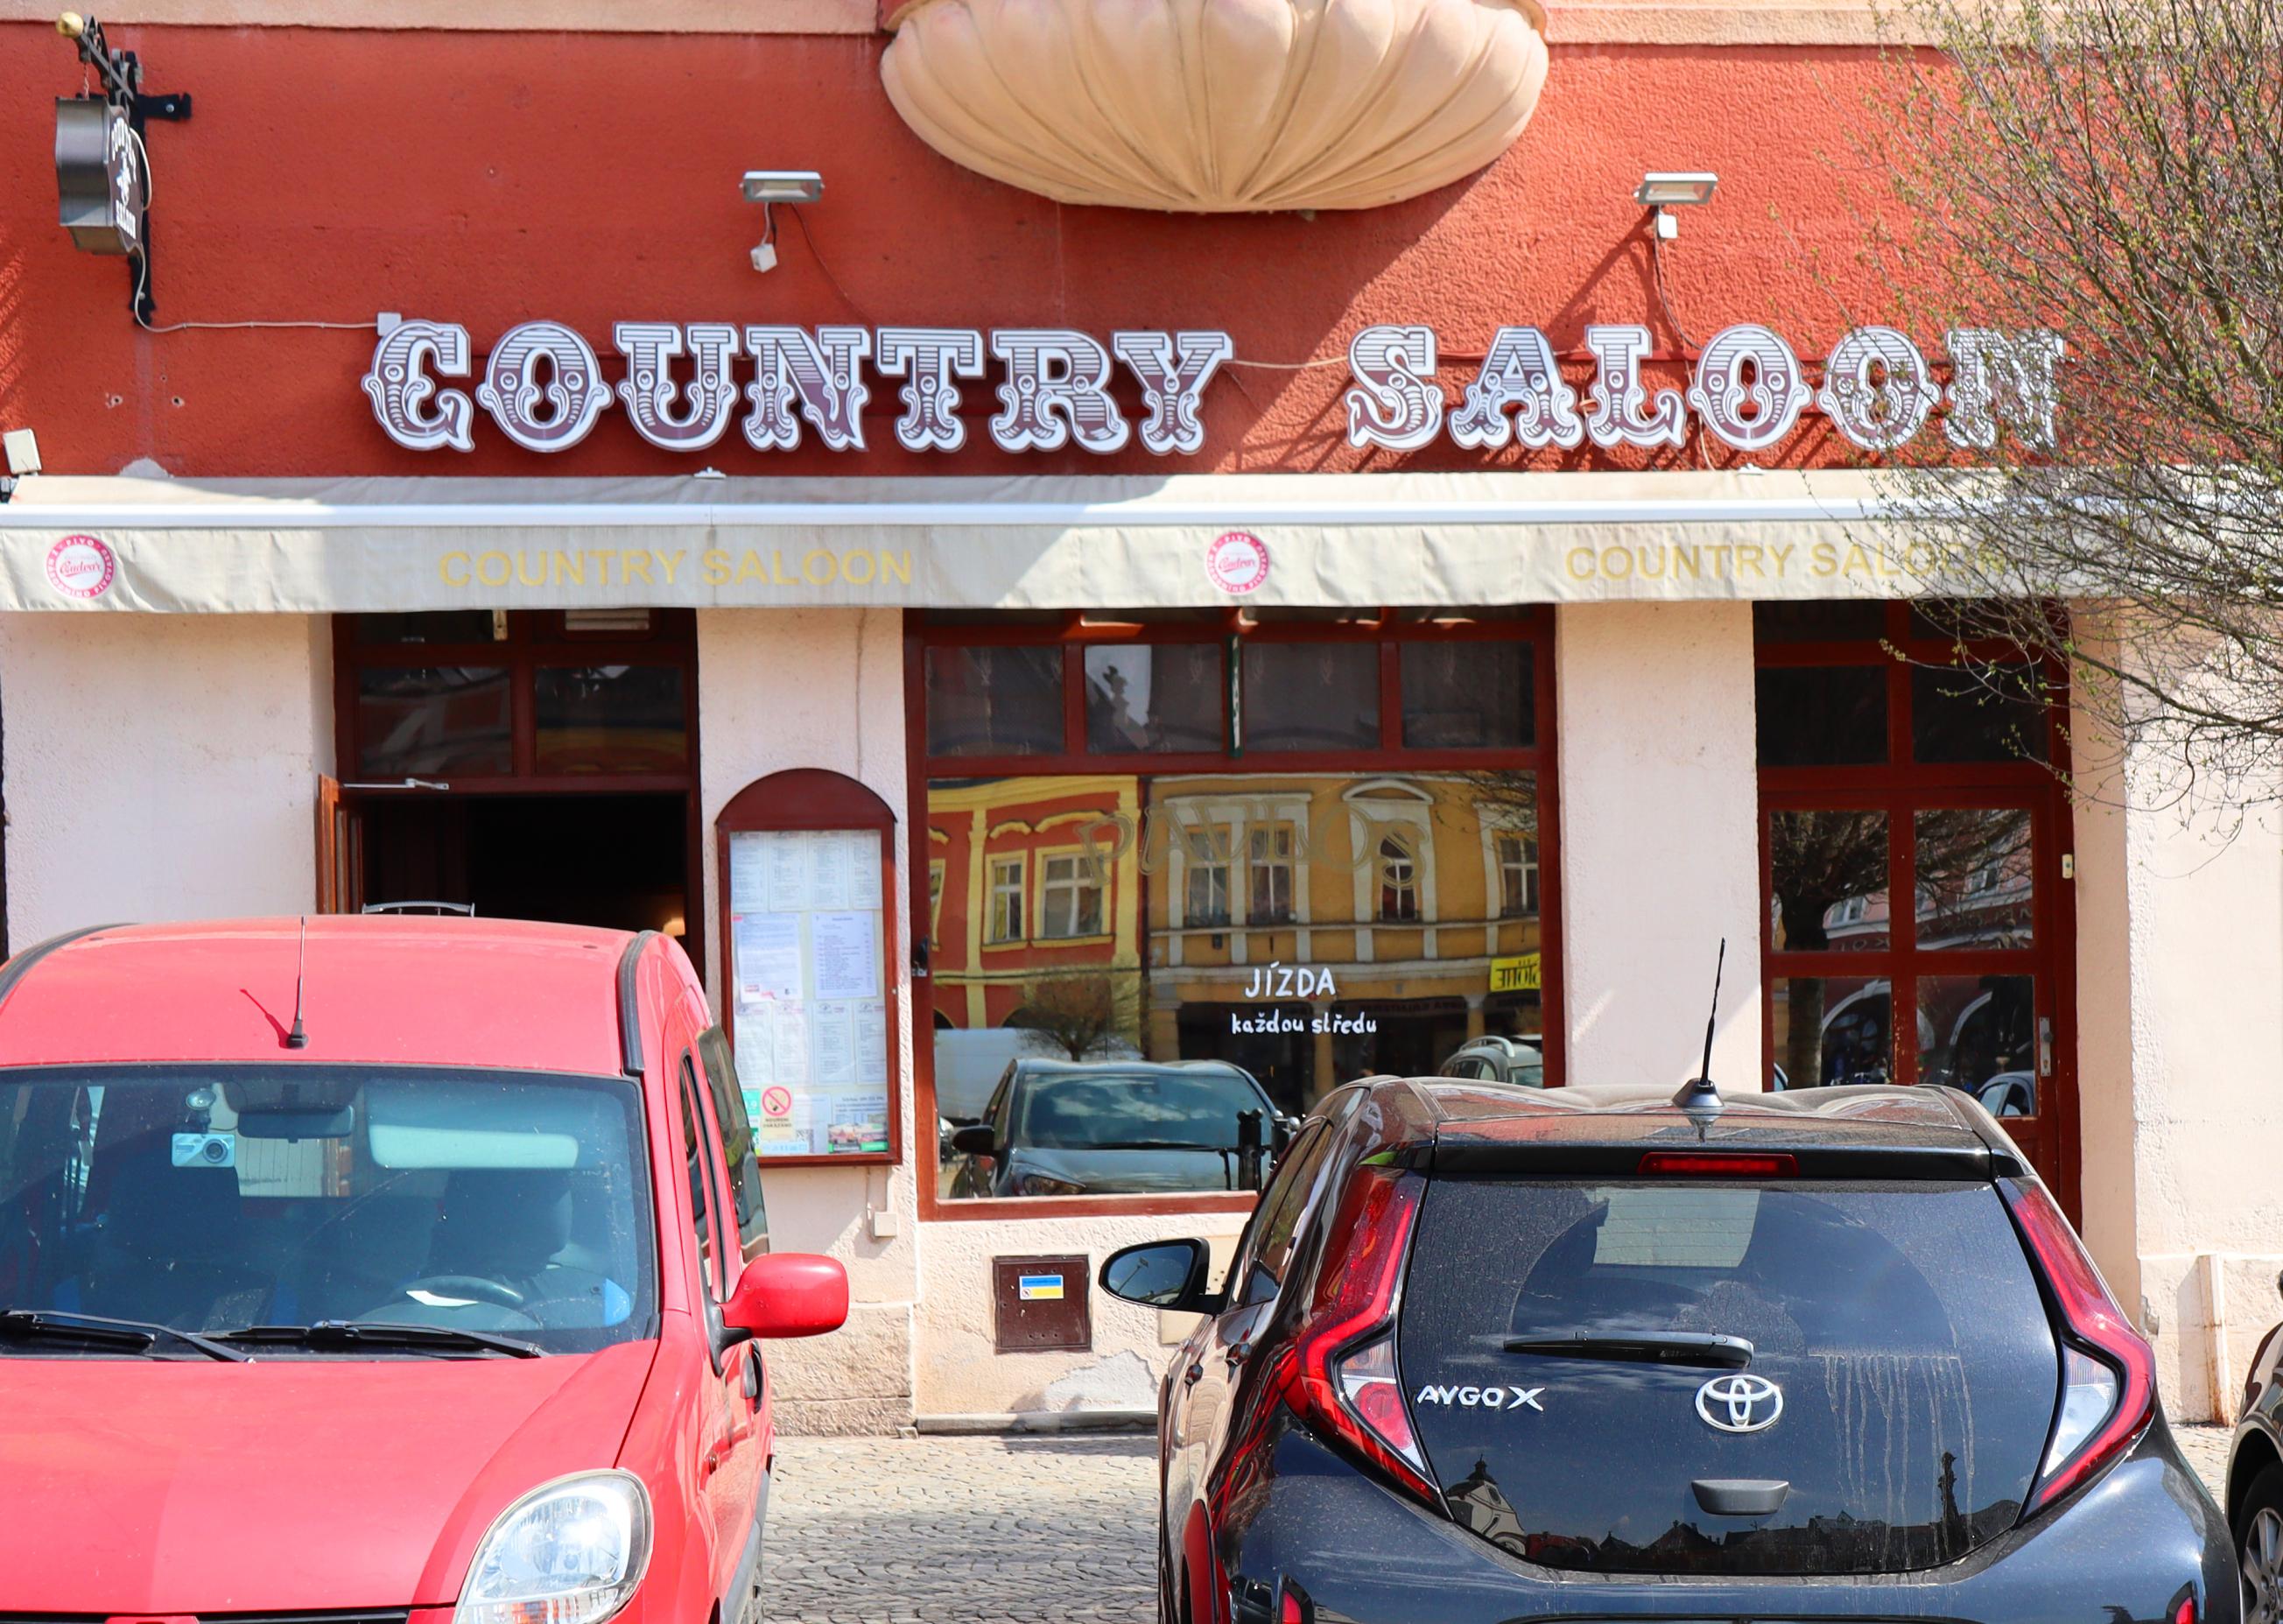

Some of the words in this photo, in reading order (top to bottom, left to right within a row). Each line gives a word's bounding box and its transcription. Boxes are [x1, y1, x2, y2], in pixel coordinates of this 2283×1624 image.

[361, 320, 1233, 453] COUNTRY
[1348, 324, 2068, 453] SALOON
[439, 549, 686, 587] COUNTRY
[702, 548, 912, 586] SALOON
[1565, 544, 1794, 581] COUNTRY
[1245, 960, 1336, 998] JÍZDA
[1231, 1009, 1304, 1035] každou
[1416, 1384, 1505, 1408] AYGO
[1507, 1386, 1547, 1412] X
